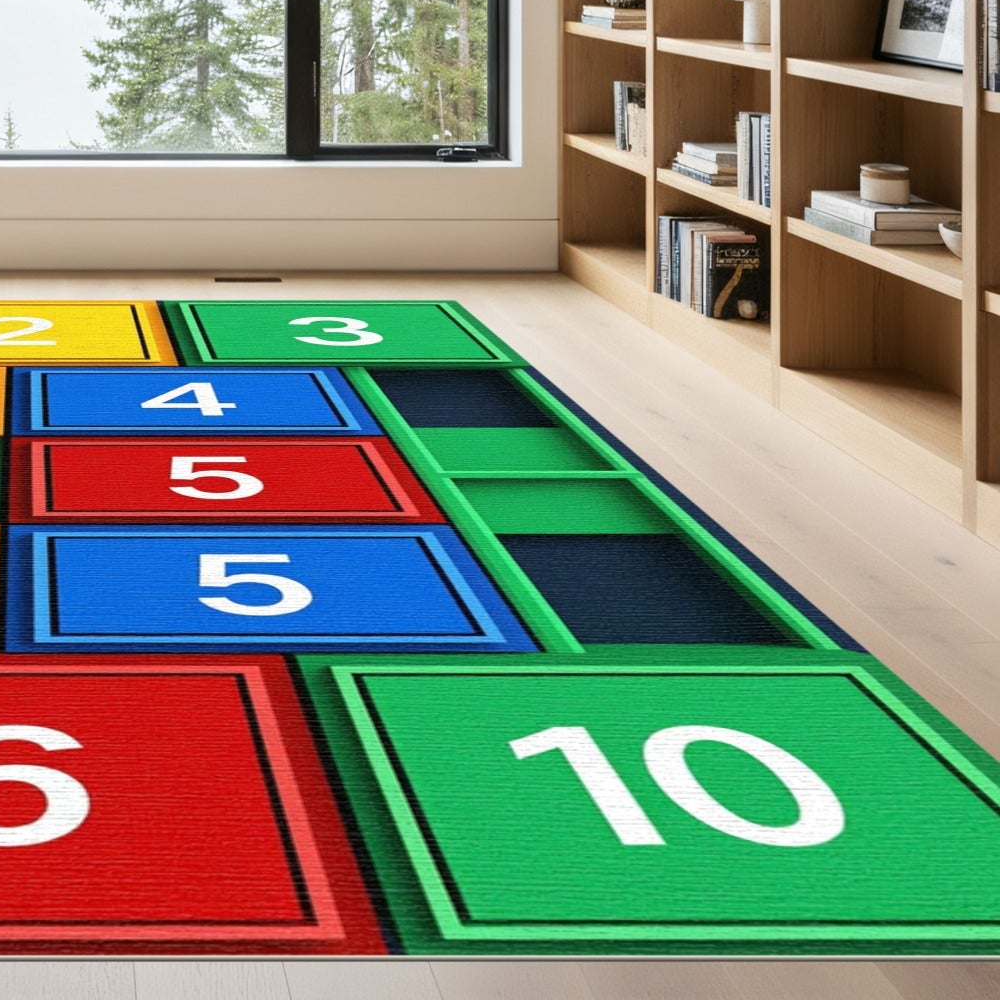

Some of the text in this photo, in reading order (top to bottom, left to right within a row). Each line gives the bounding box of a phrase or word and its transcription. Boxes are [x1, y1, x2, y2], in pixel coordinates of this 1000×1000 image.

[288, 316, 384, 347] 3
[141, 382, 237, 417] 4
[169, 456, 264, 500] 5
[197, 553, 313, 617] 5
[509, 724, 846, 847] 10
